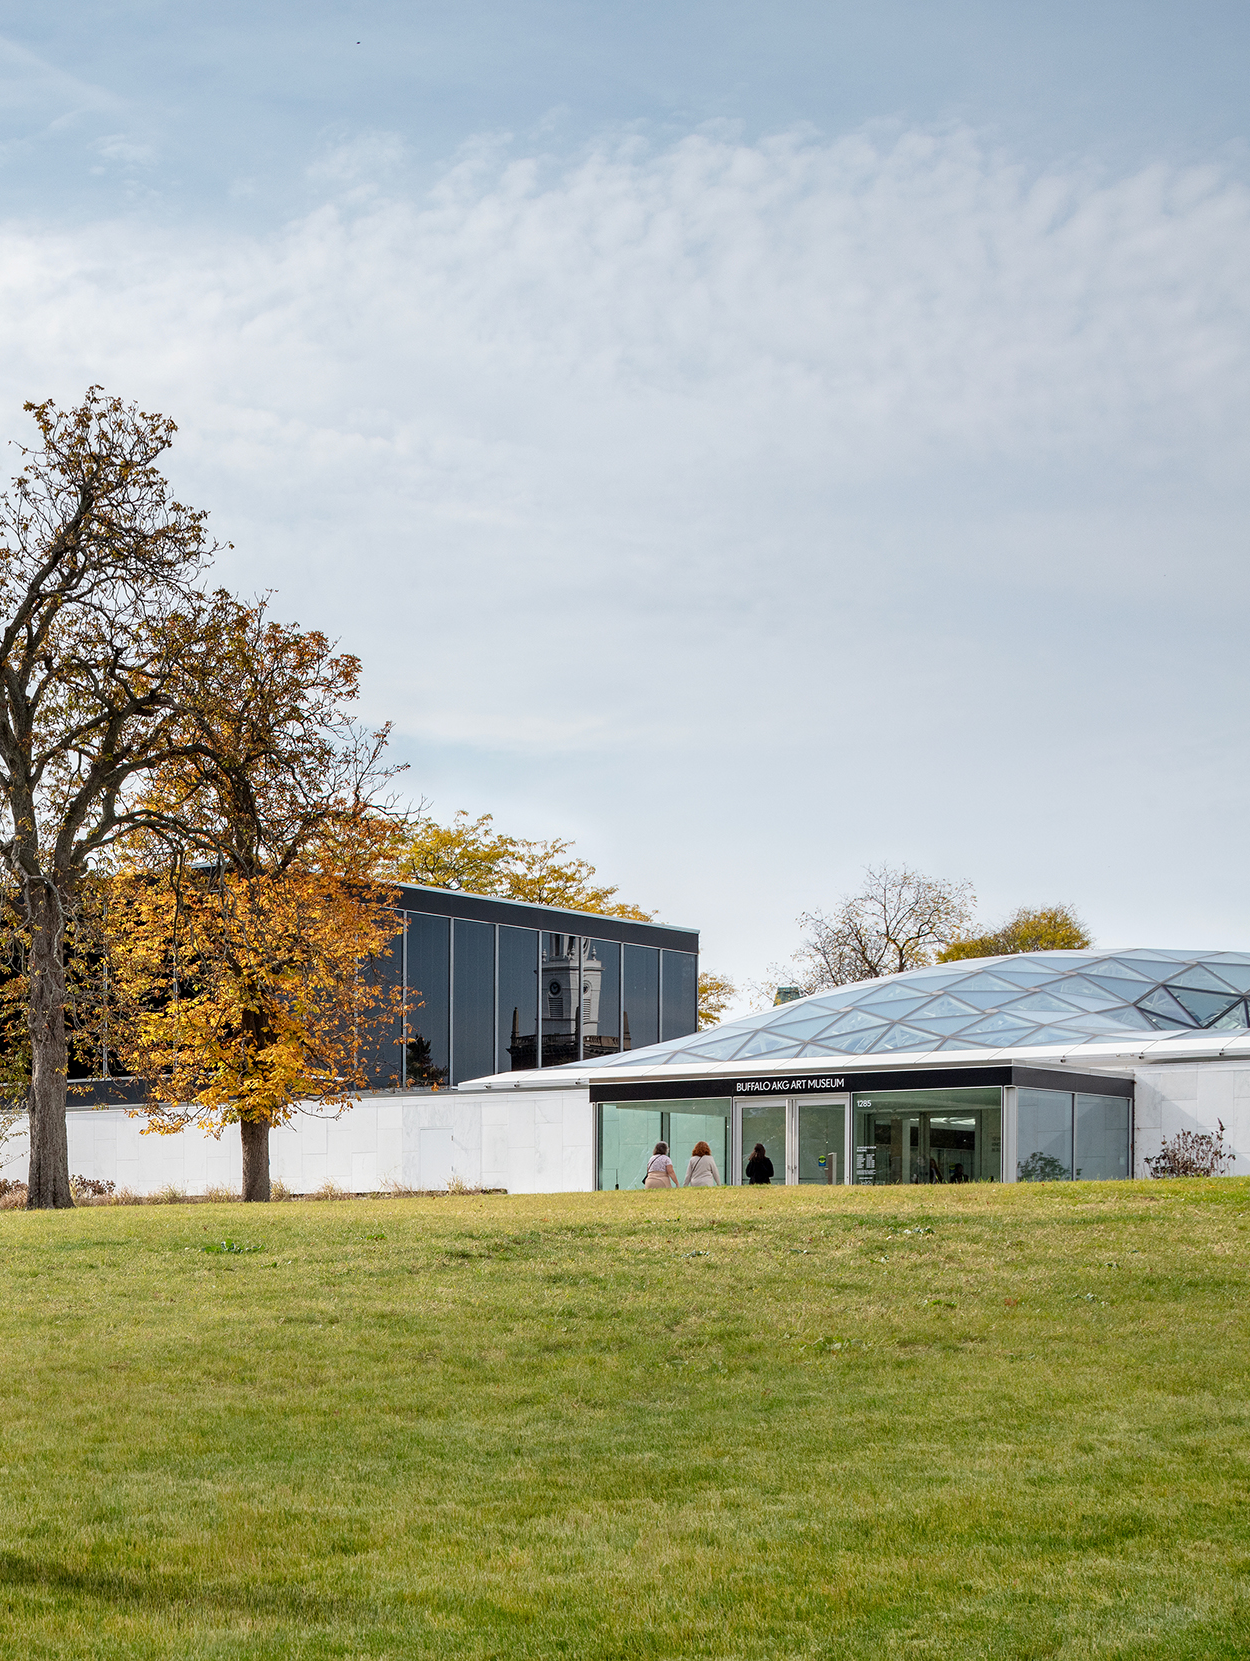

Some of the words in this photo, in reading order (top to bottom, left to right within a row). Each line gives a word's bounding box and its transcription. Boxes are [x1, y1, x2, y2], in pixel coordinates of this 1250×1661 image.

[736, 1081, 771, 1092] BUFFALO
[771, 1080, 790, 1091] AKG
[790, 1079, 806, 1090] ART
[807, 1078, 845, 1089] MUSEUM
[856, 1099, 872, 1108] 1285
